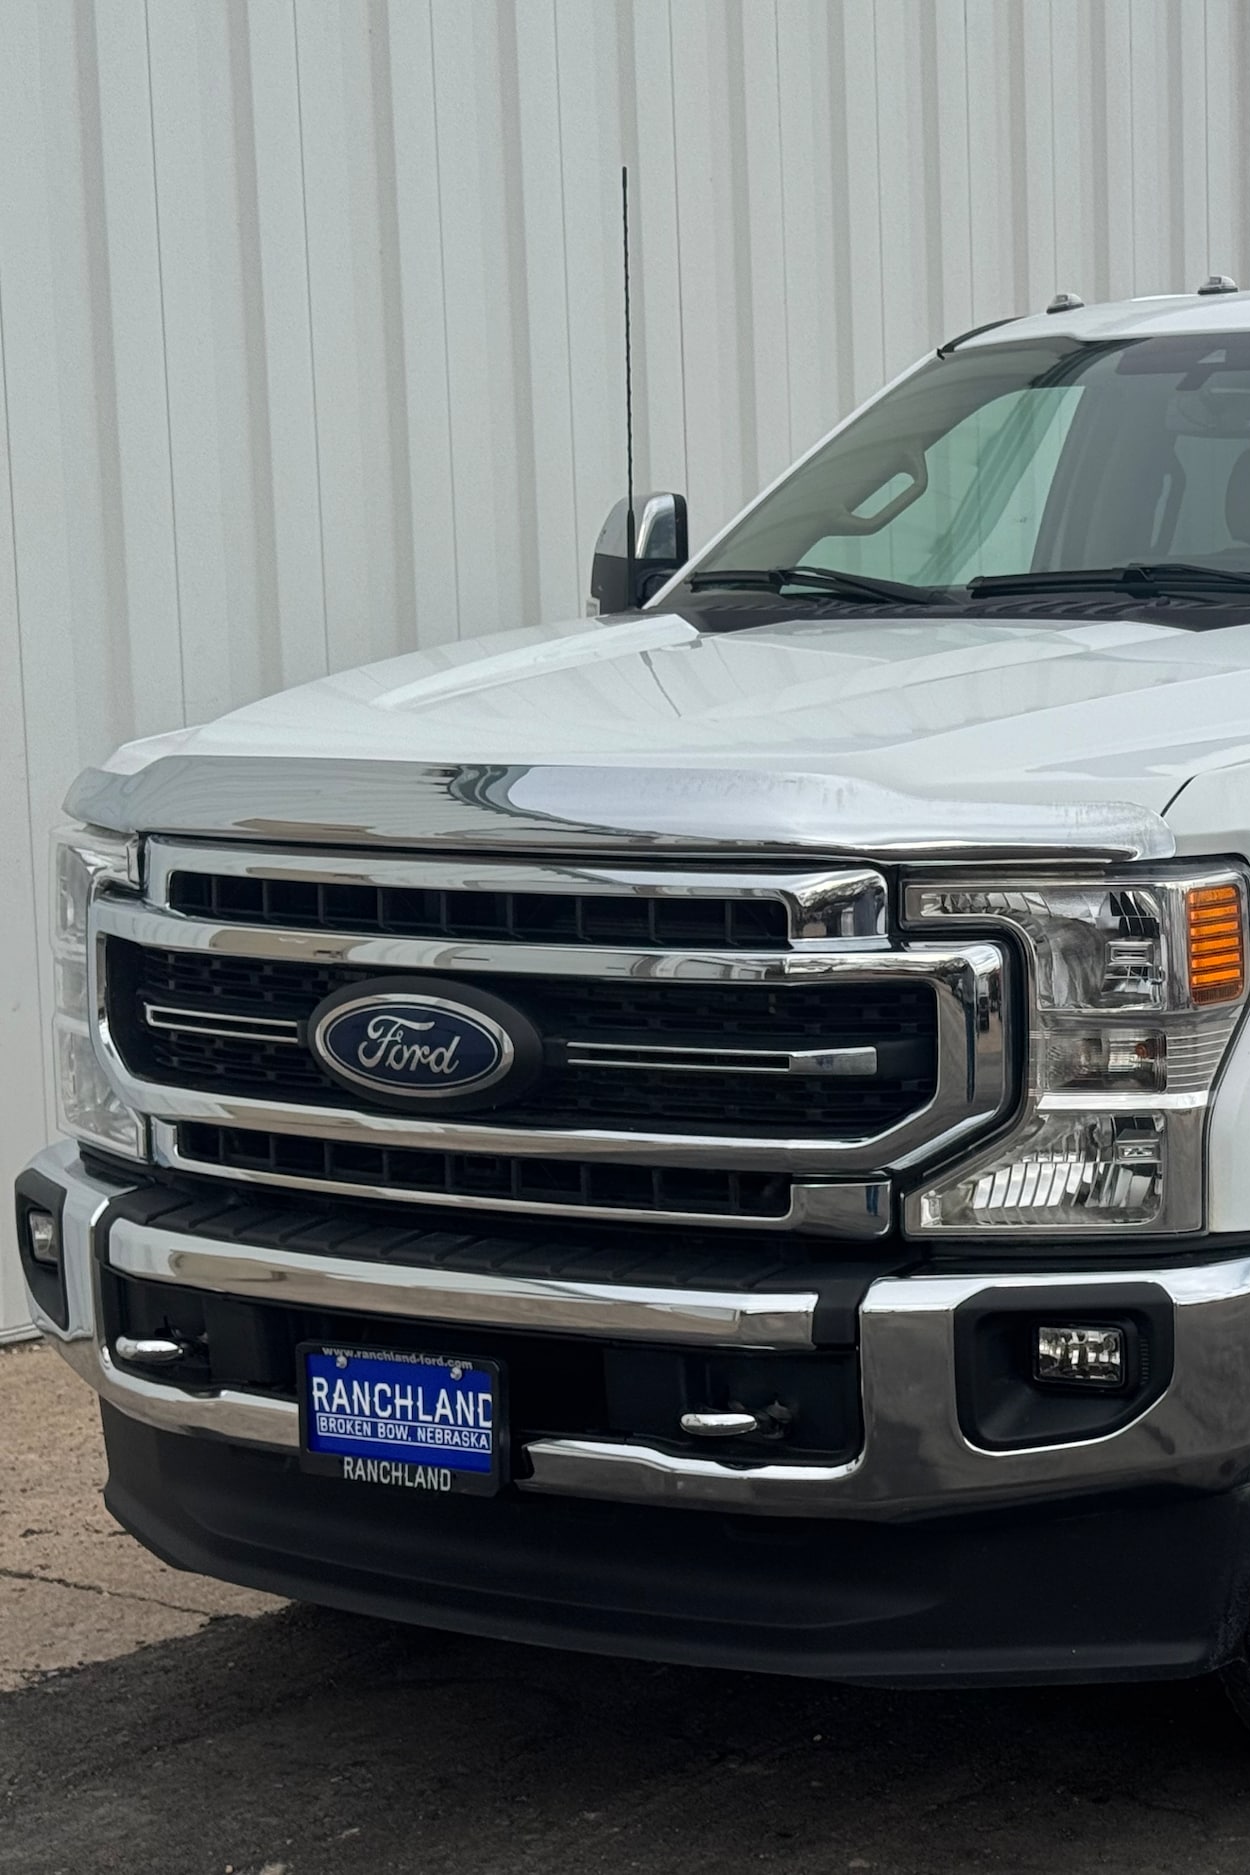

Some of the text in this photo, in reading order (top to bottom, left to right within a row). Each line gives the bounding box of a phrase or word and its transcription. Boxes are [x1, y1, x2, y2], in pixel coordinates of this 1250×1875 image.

[358, 1014, 462, 1075] Ford
[321, 1346, 473, 1370] www.ranchland-ford.com
[312, 1376, 493, 1429] RANCHLAND
[319, 1415, 371, 1437] BROKEN
[417, 1427, 489, 1449] NEBRASKA
[343, 1456, 451, 1492] RANCHLAND
